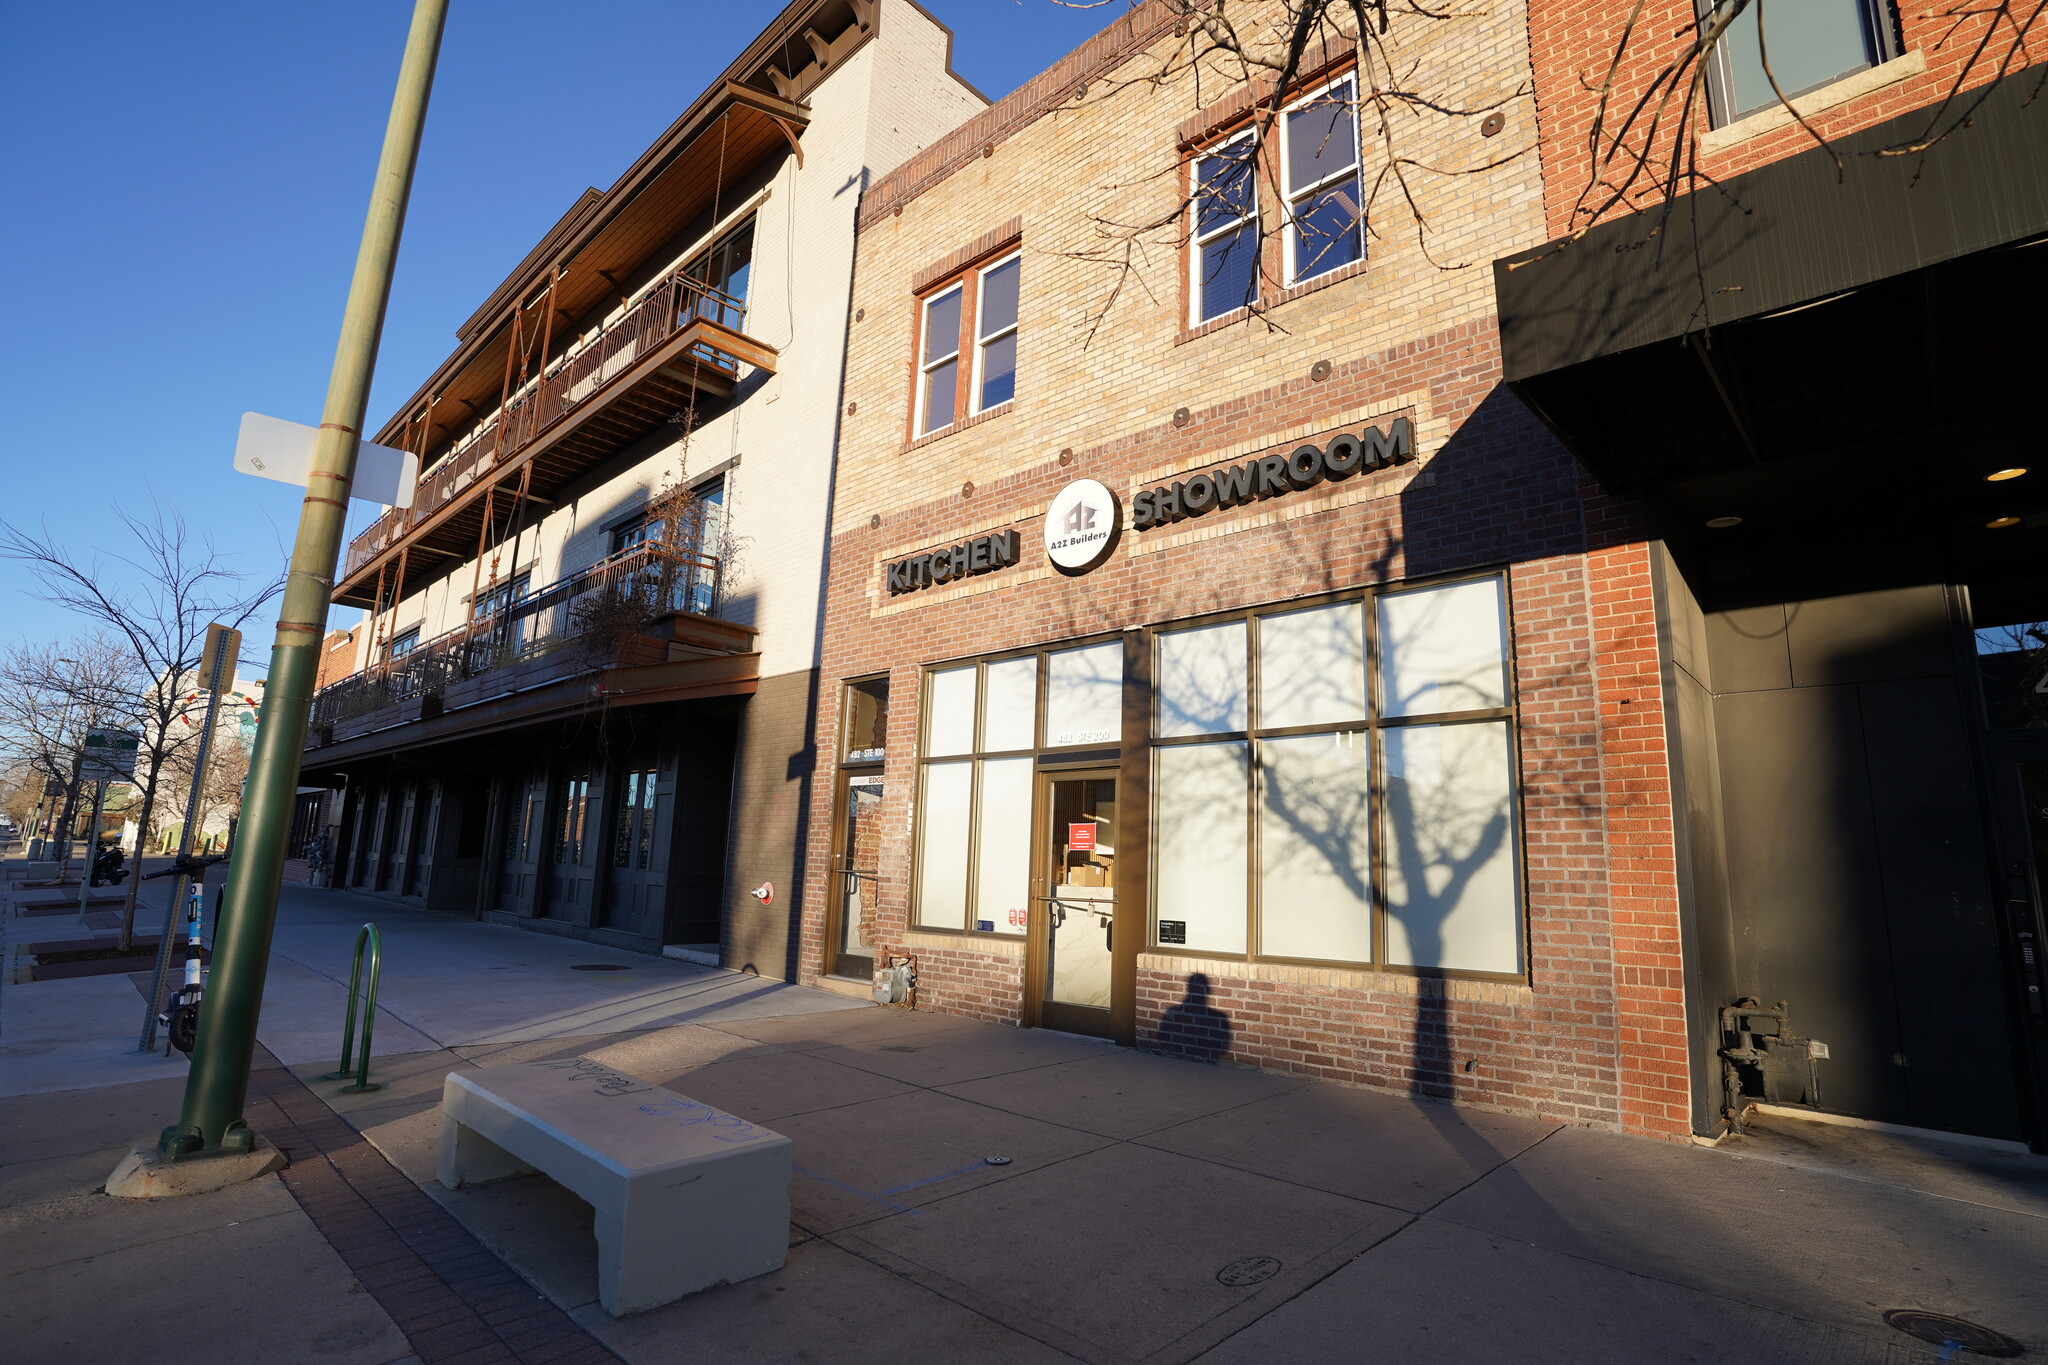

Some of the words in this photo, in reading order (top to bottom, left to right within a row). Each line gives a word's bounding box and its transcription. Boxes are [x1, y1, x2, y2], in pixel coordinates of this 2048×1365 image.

[1132, 417, 1415, 530] SHOWROOM
[1050, 539, 1069, 550] A2Z
[1070, 531, 1107, 546] Builders
[886, 528, 1019, 594] KITCHEN
[1078, 729, 1092, 743] STE
[1093, 728, 1110, 742] 200
[850, 750, 861, 759] 482
[863, 748, 873, 757] STE
[874, 747, 884, 756] 100
